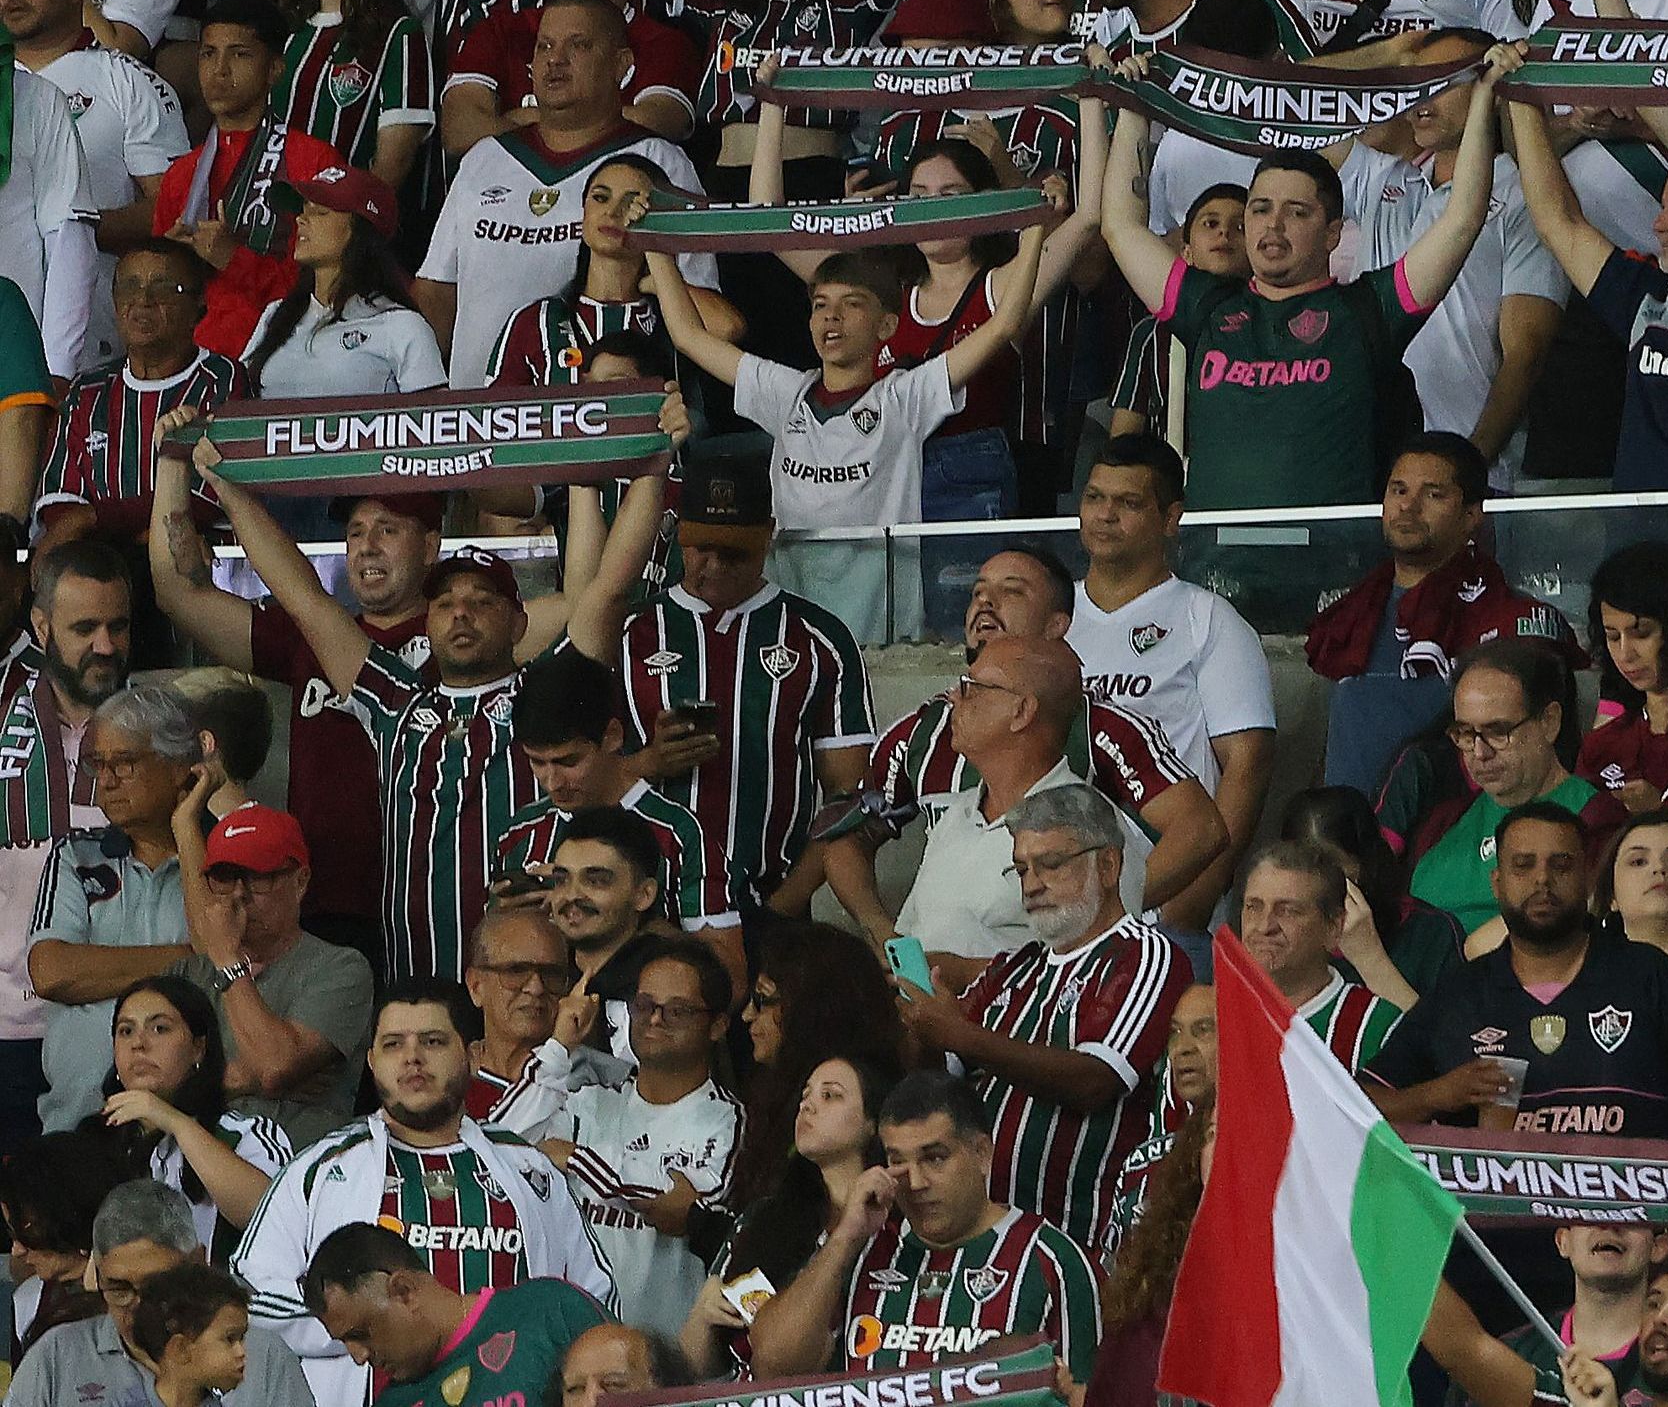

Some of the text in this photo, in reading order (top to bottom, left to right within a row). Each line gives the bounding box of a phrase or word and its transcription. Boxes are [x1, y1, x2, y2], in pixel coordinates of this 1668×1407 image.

[874, 72, 974, 94] SUPERBET
[476, 220, 581, 245] SUPERBE
[791, 207, 894, 235] SUPERBET
[1225, 359, 1331, 384] BETANO
[266, 403, 607, 455] FLUMINENSE FC
[382, 450, 492, 477] SUPERBET
[1084, 675, 1151, 698] TANO
[1515, 1105, 1623, 1134] BETANO
[408, 1224, 521, 1253] BETANO
[943, 1362, 999, 1396] FC
